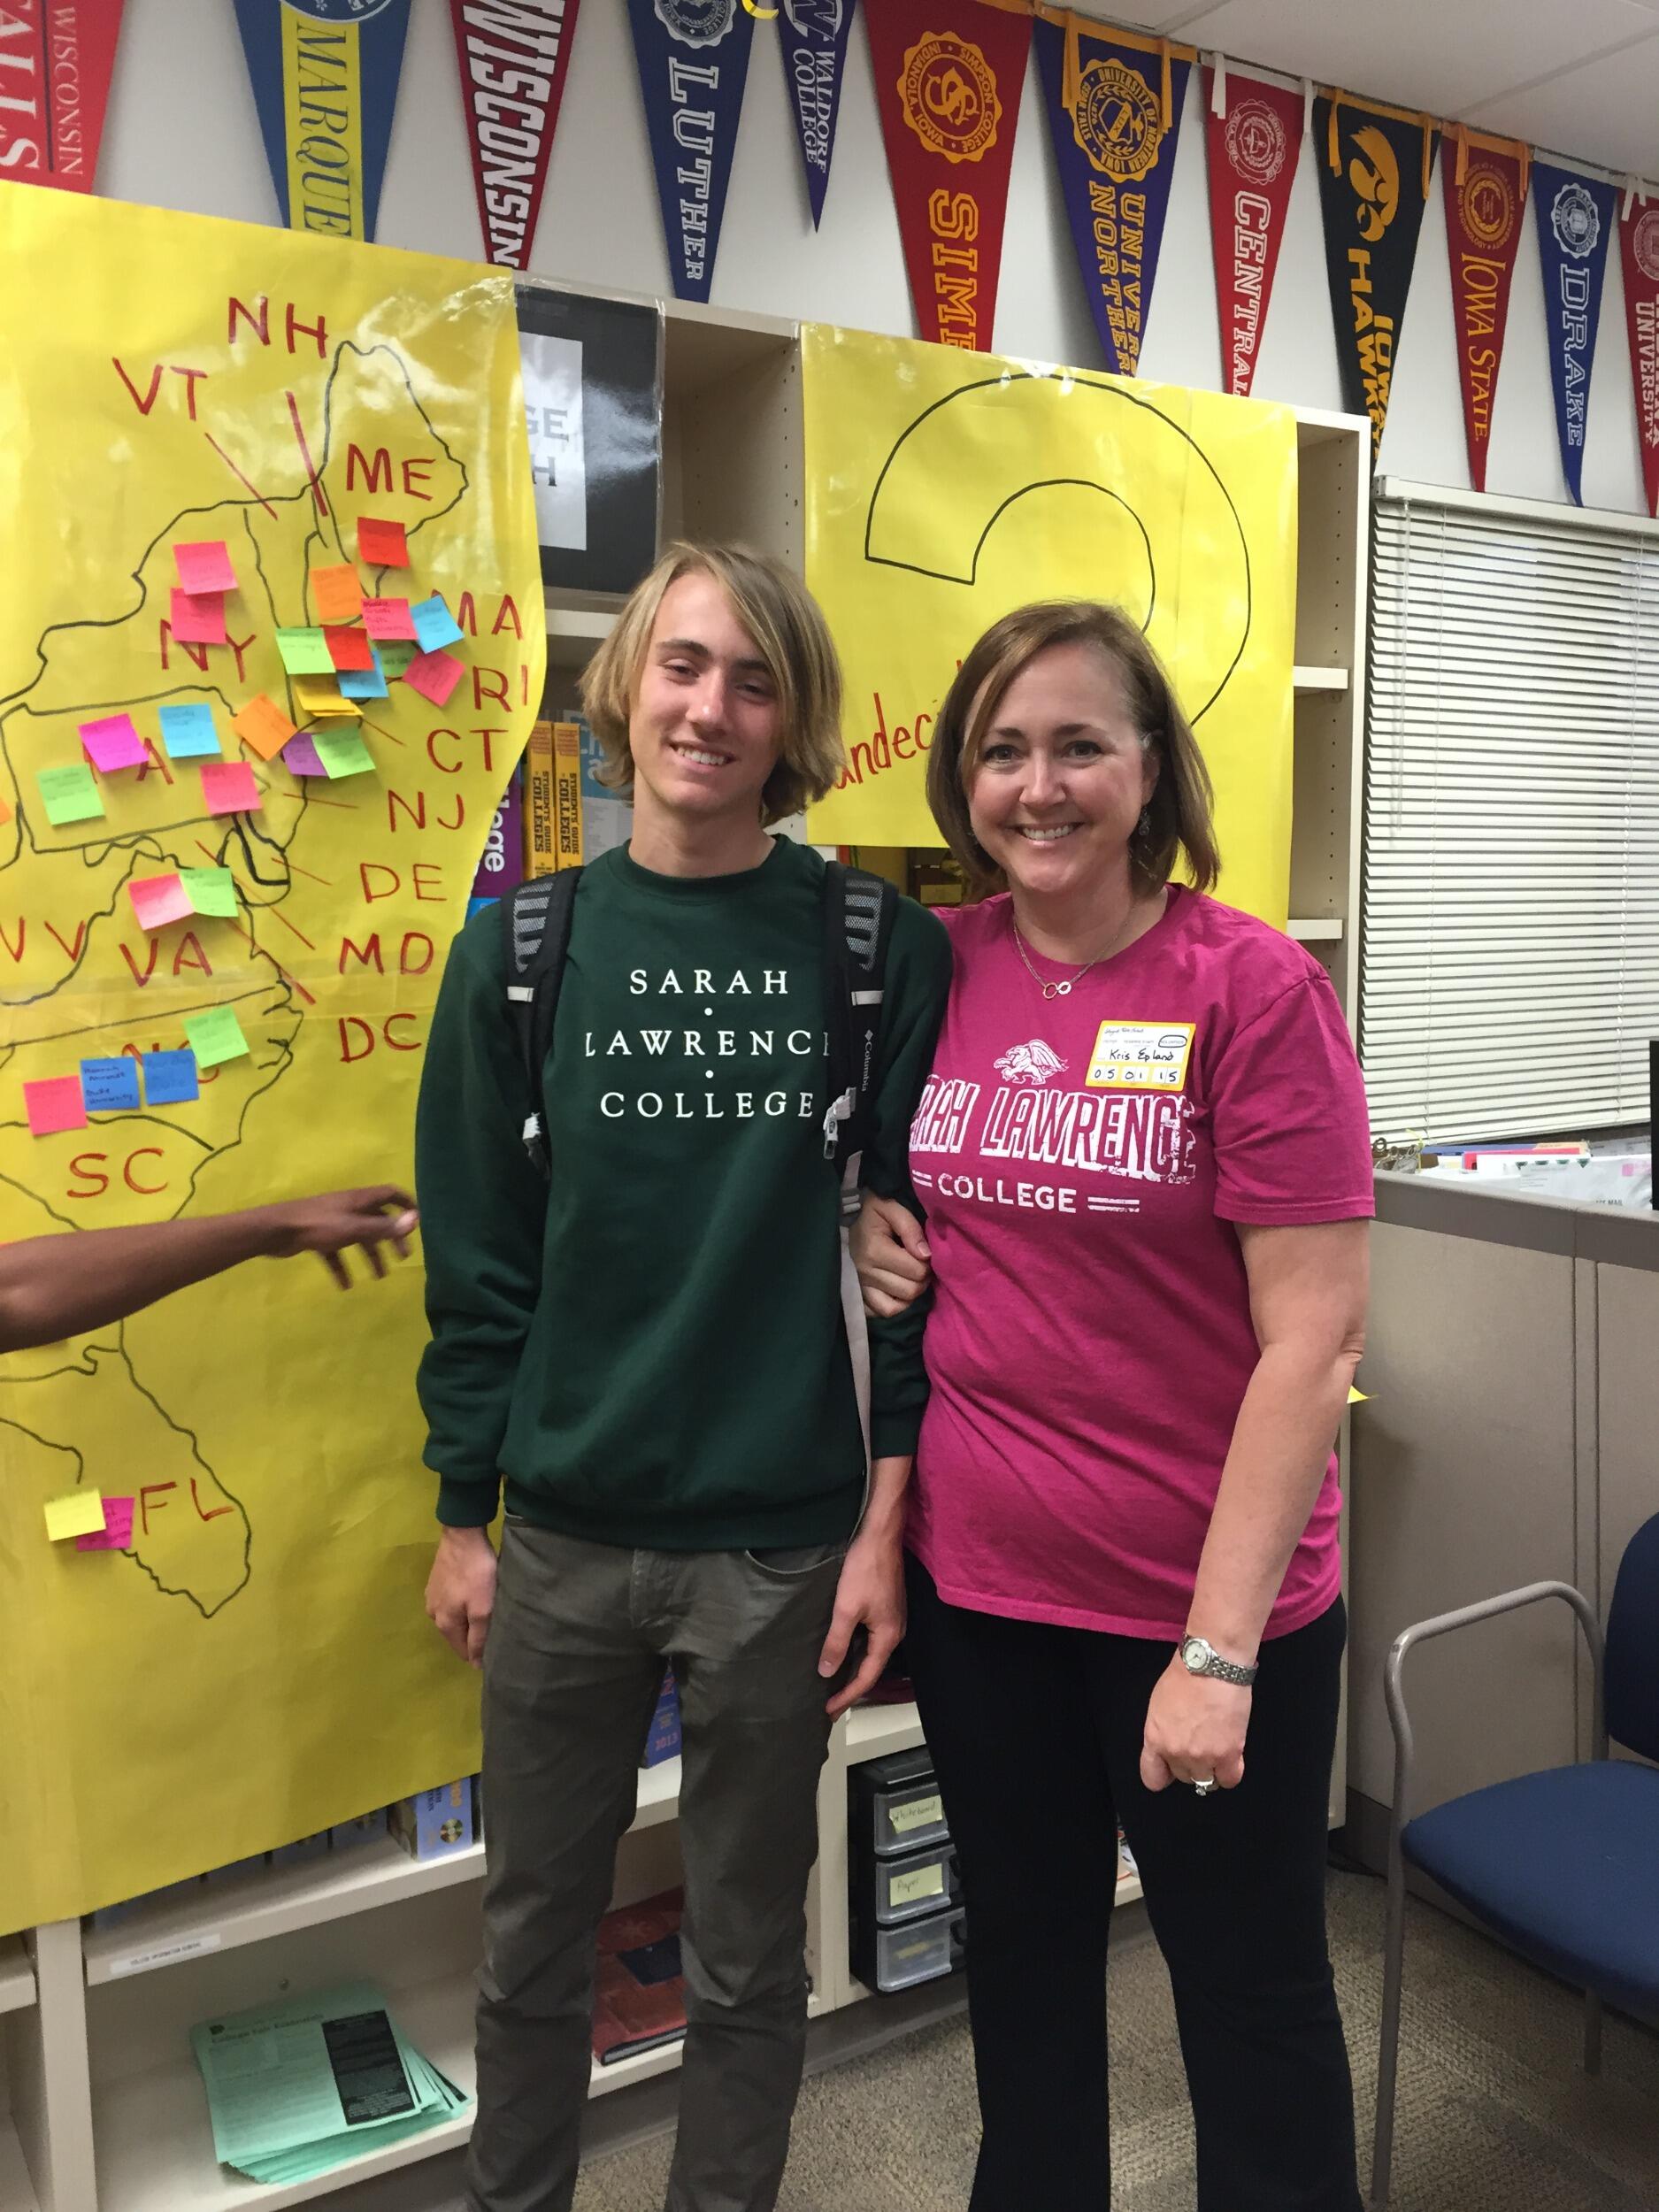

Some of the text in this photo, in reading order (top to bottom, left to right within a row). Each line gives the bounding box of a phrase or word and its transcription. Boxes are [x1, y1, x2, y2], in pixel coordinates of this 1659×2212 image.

[53, 7, 83, 175] WISCONSIN
[793, 49, 818, 163] COLLEGE
[815, 50, 835, 173] WALDORF
[960, 47, 994, 153] SIMPSON COLLEGE
[1098, 67, 1151, 105] UNIVERSITY
[464, 0, 566, 269] WISCONSIN
[915, 112, 944, 147] IOWA
[669, 57, 718, 280] LUTHER
[1089, 180, 1132, 376] NORTHER
[1233, 190, 1271, 396] CENTRAL
[228, 296, 328, 359] NH
[1461, 252, 1507, 439] IOWA STATE
[1561, 264, 1589, 446] DRAKE
[111, 357, 208, 421] VT
[1636, 302, 1656, 443] UNIVERSITY
[346, 443, 437, 501] ME
[473, 665, 529, 712] RI
[426, 729, 509, 774] CT
[388, 789, 465, 832] NJ
[533, 777, 544, 853] COLLEGES
[559, 779, 572, 854] COLLEGES
[360, 863, 448, 903] DE
[119, 932, 213, 987] VA
[339, 932, 434, 975] MD
[629, 969, 788, 995] SARAH
[340, 1013, 423, 1063] DC
[861, 1041, 872, 1093] Columbia
[1109, 1048, 1130, 1060] Kris
[600, 1092, 814, 1118] COLLEGE
[67, 1148, 168, 1198] SC
[937, 1171, 1078, 1213] COLLEGE
[141, 1477, 235, 1536] FL
